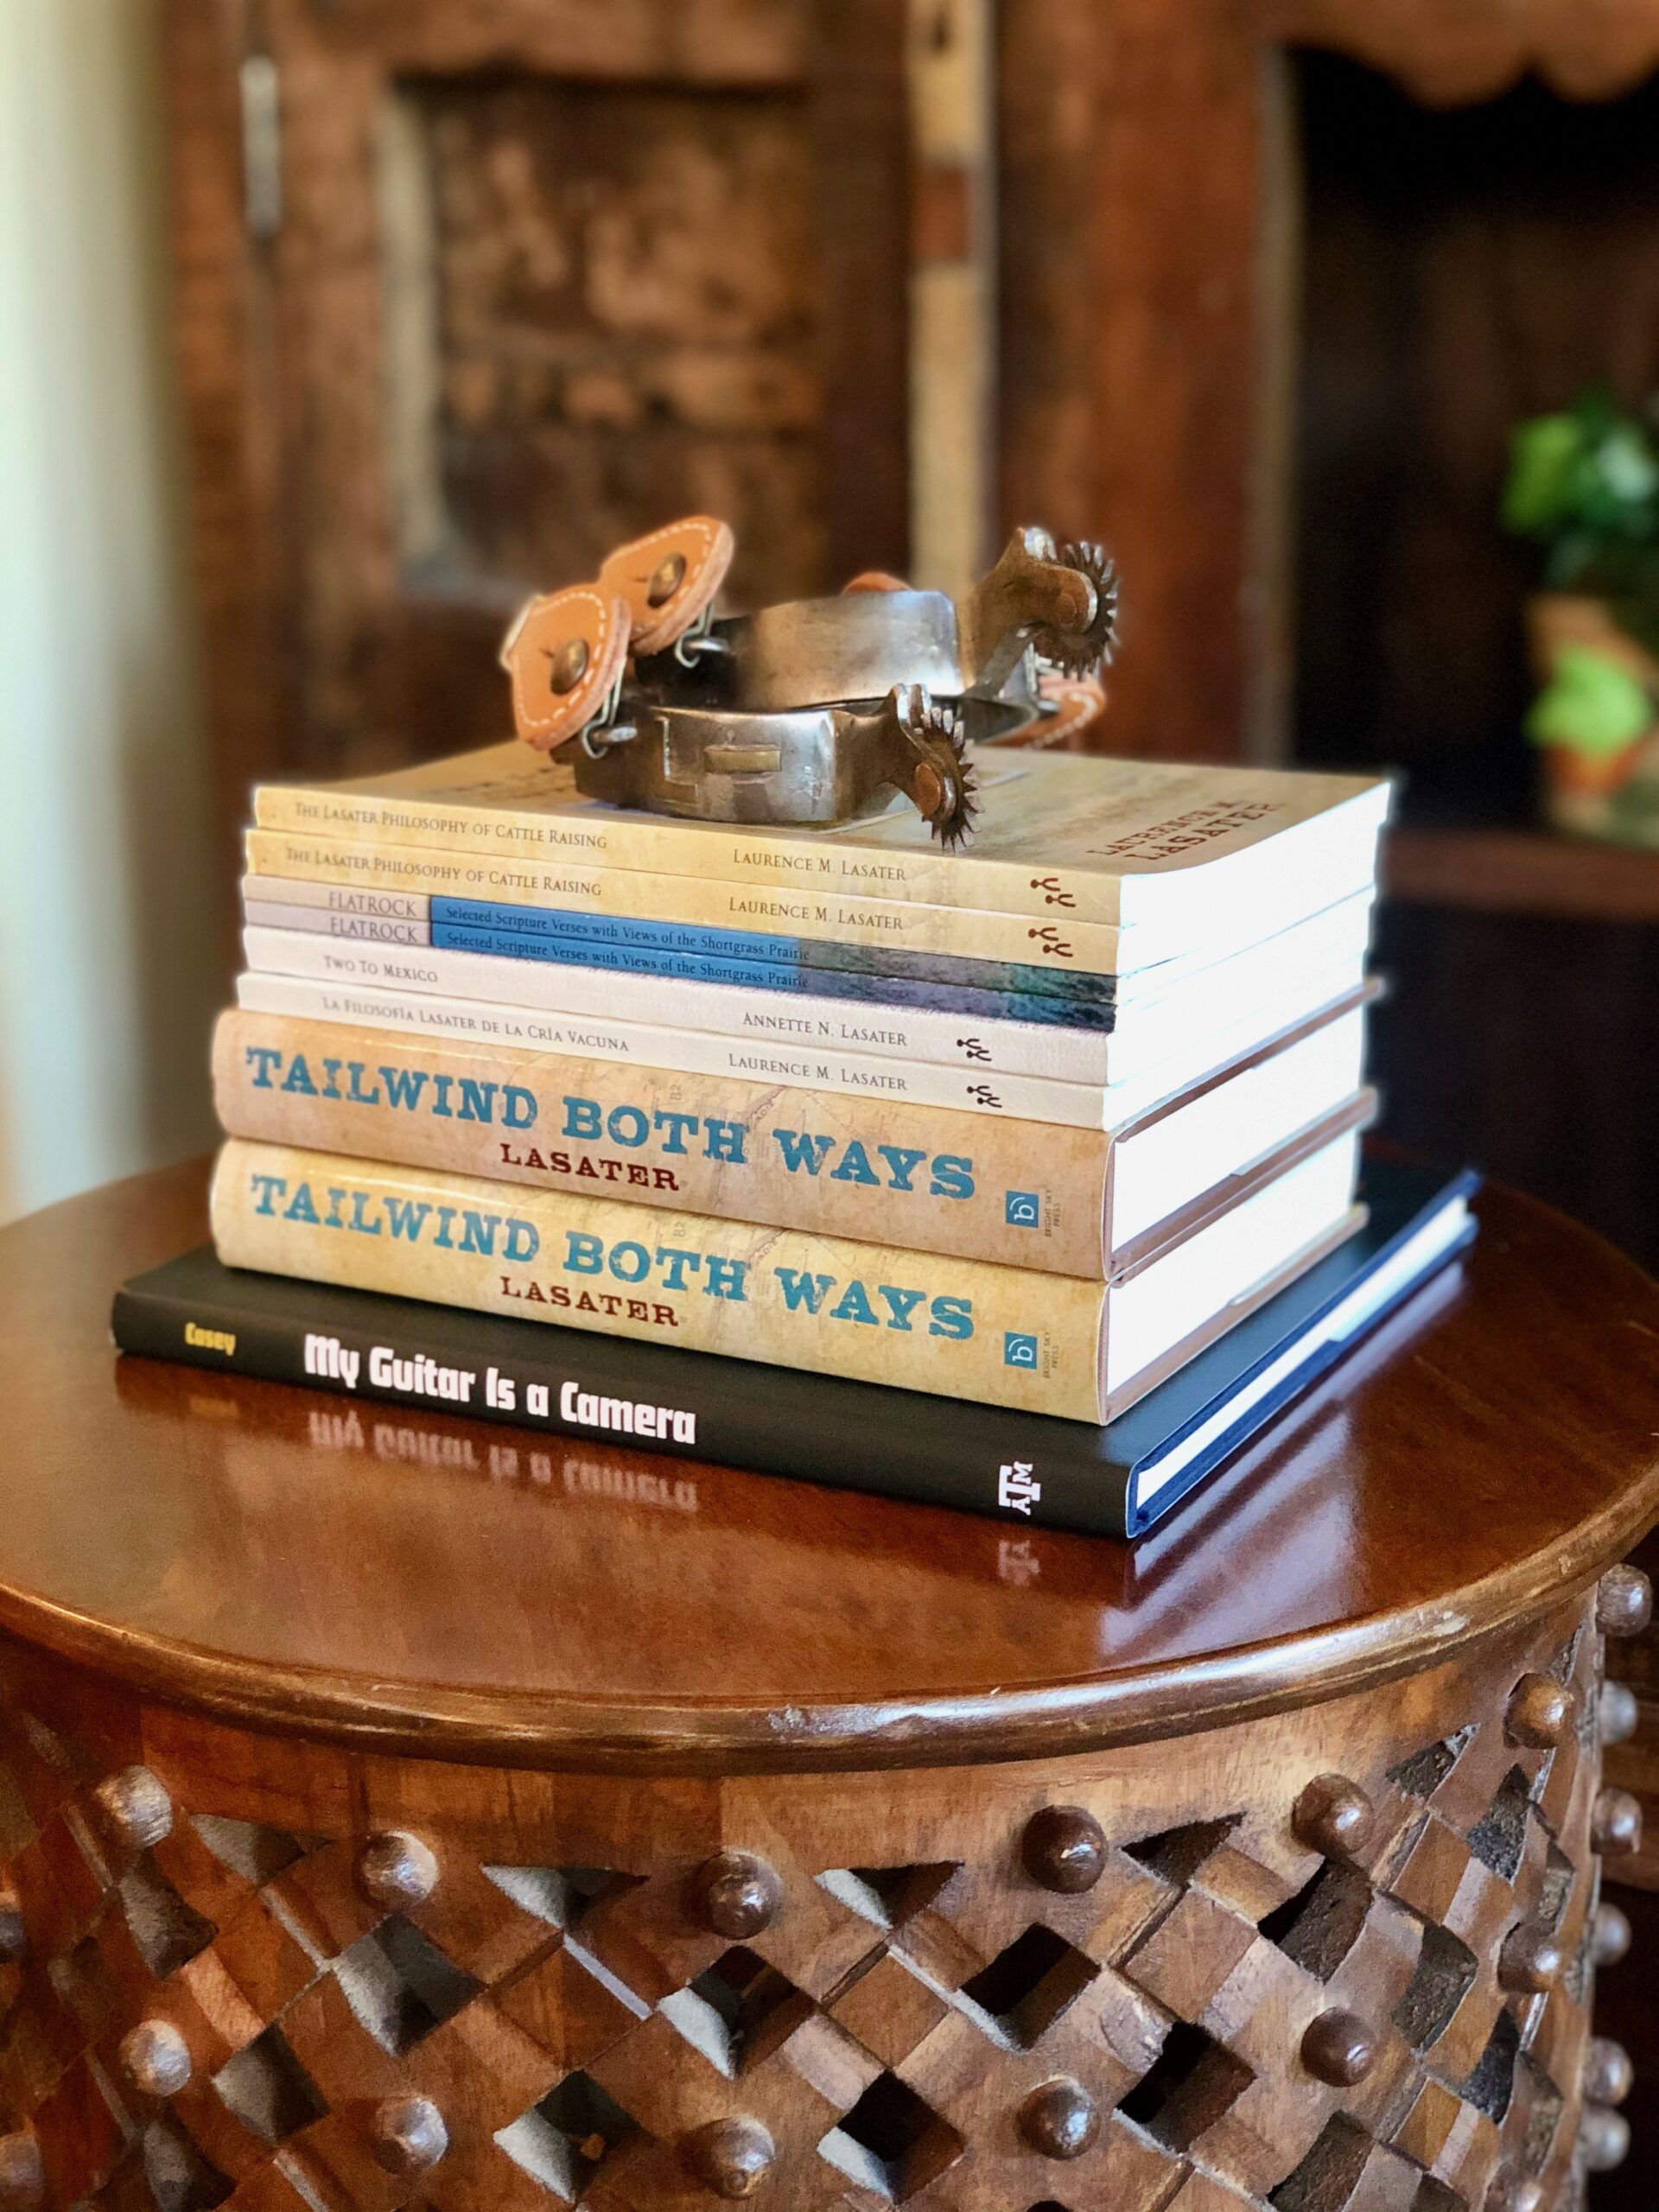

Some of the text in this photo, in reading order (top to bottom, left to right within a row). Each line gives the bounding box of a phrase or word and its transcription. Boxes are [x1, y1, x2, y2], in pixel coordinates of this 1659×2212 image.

[296, 803, 608, 849] THE LASATER PHILOSOPHY OF CATTLE RAISING
[286, 847, 602, 896] THE LASATER PHILOSOPHY OF CATTLE RAISING
[734, 849, 906, 881] LAURENCE M. LASATER
[328, 891, 417, 918] FLATROCK
[729, 897, 903, 930] LAURENCE M. LASATER
[330, 917, 418, 944] FLATROCK
[446, 906, 492, 923] Selected
[496, 913, 547, 931] Scripture
[552, 918, 588, 934] Verses
[592, 925, 619, 938] with
[622, 926, 657, 942] Views
[661, 929, 673, 944] of
[677, 932, 696, 947] the
[701, 936, 765, 956] Shortgrass
[383, 963, 439, 983] MEXICO
[447, 932, 493, 949] Selected
[497, 939, 548, 957] Scripture
[552, 944, 588, 961] Verses
[592, 952, 619, 964] with
[622, 953, 657, 969] Views
[661, 957, 673, 971] of
[677, 959, 696, 975] the
[700, 963, 764, 982] Shortgrass
[419, 1010, 477, 1030] LASATER
[481, 1020, 500, 1033] DE
[505, 1023, 523, 1036] LA
[527, 1025, 563, 1043] CRÍA
[568, 1031, 630, 1052] VACUNA
[743, 1012, 908, 1046] ANNETTE N. LASATER
[728, 1052, 908, 1090] LAURENCE M. LASATER
[245, 1046, 976, 1199] TAILWIND BOTH WAYS
[499, 1143, 679, 1192] LASATER
[251, 1174, 975, 1340] TAILWIND BOTH WAYS
[499, 1276, 678, 1326] LASATER
[185, 1322, 236, 1357] Casey
[305, 1333, 696, 1445] My Guitar Is a Camera
